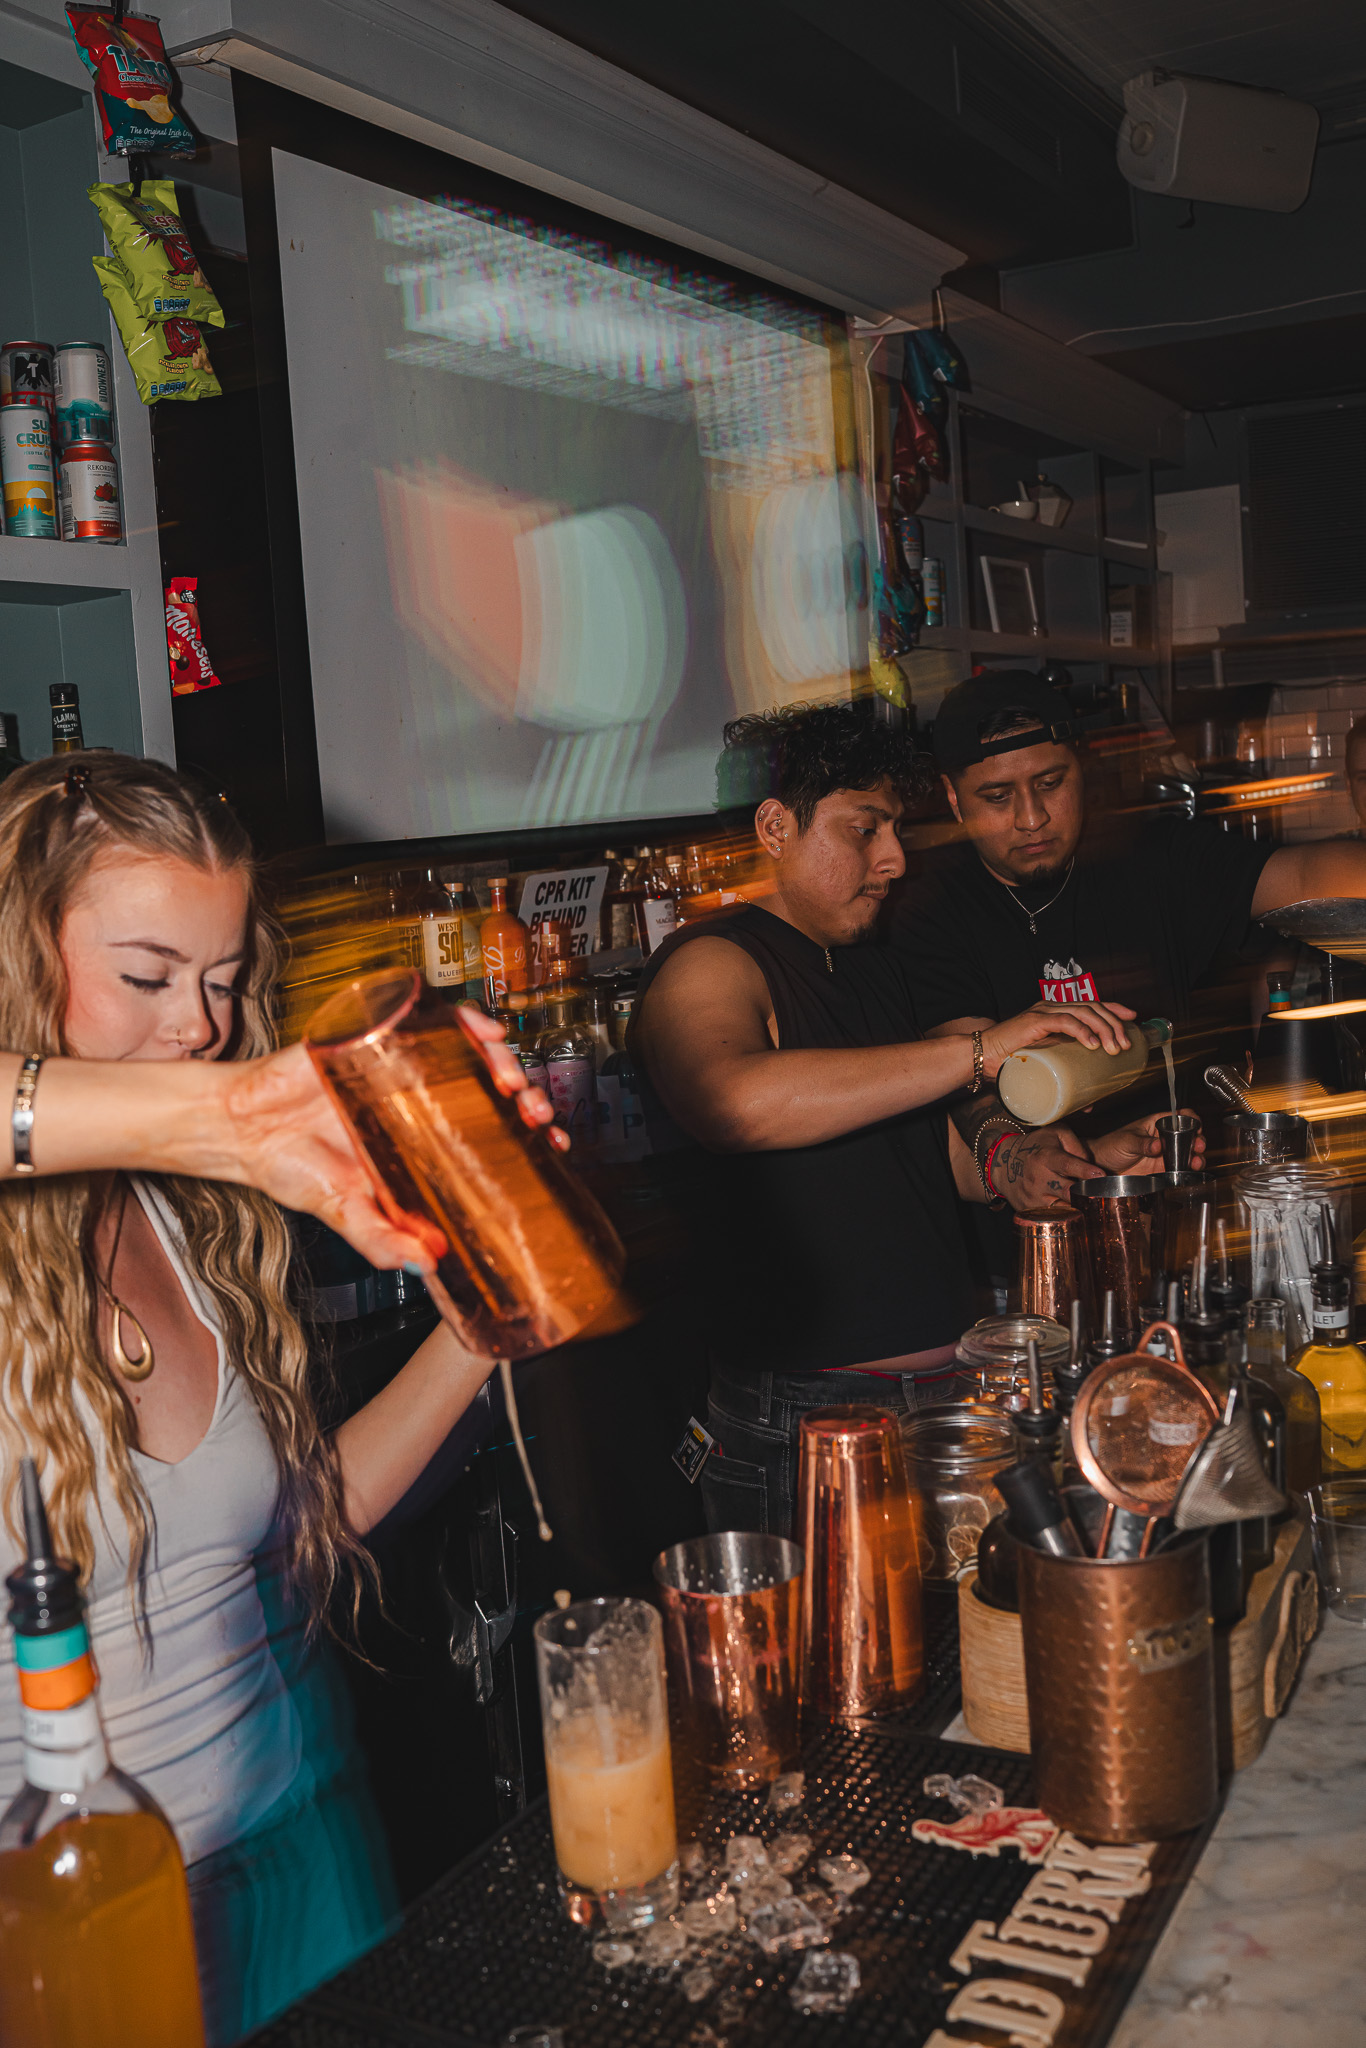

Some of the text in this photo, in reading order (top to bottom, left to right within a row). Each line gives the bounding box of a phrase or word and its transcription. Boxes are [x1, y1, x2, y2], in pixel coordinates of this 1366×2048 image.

[129, 125, 143, 135] The
[143, 126, 168, 139] Original
[168, 127, 183, 138] Irish
[96, 353, 108, 397] DOWNEAST
[31, 418, 50, 433] SU
[165, 605, 214, 678] Maltesers
[535, 876, 596, 906] CPR KIT
[1043, 978, 1095, 1003] KITH
